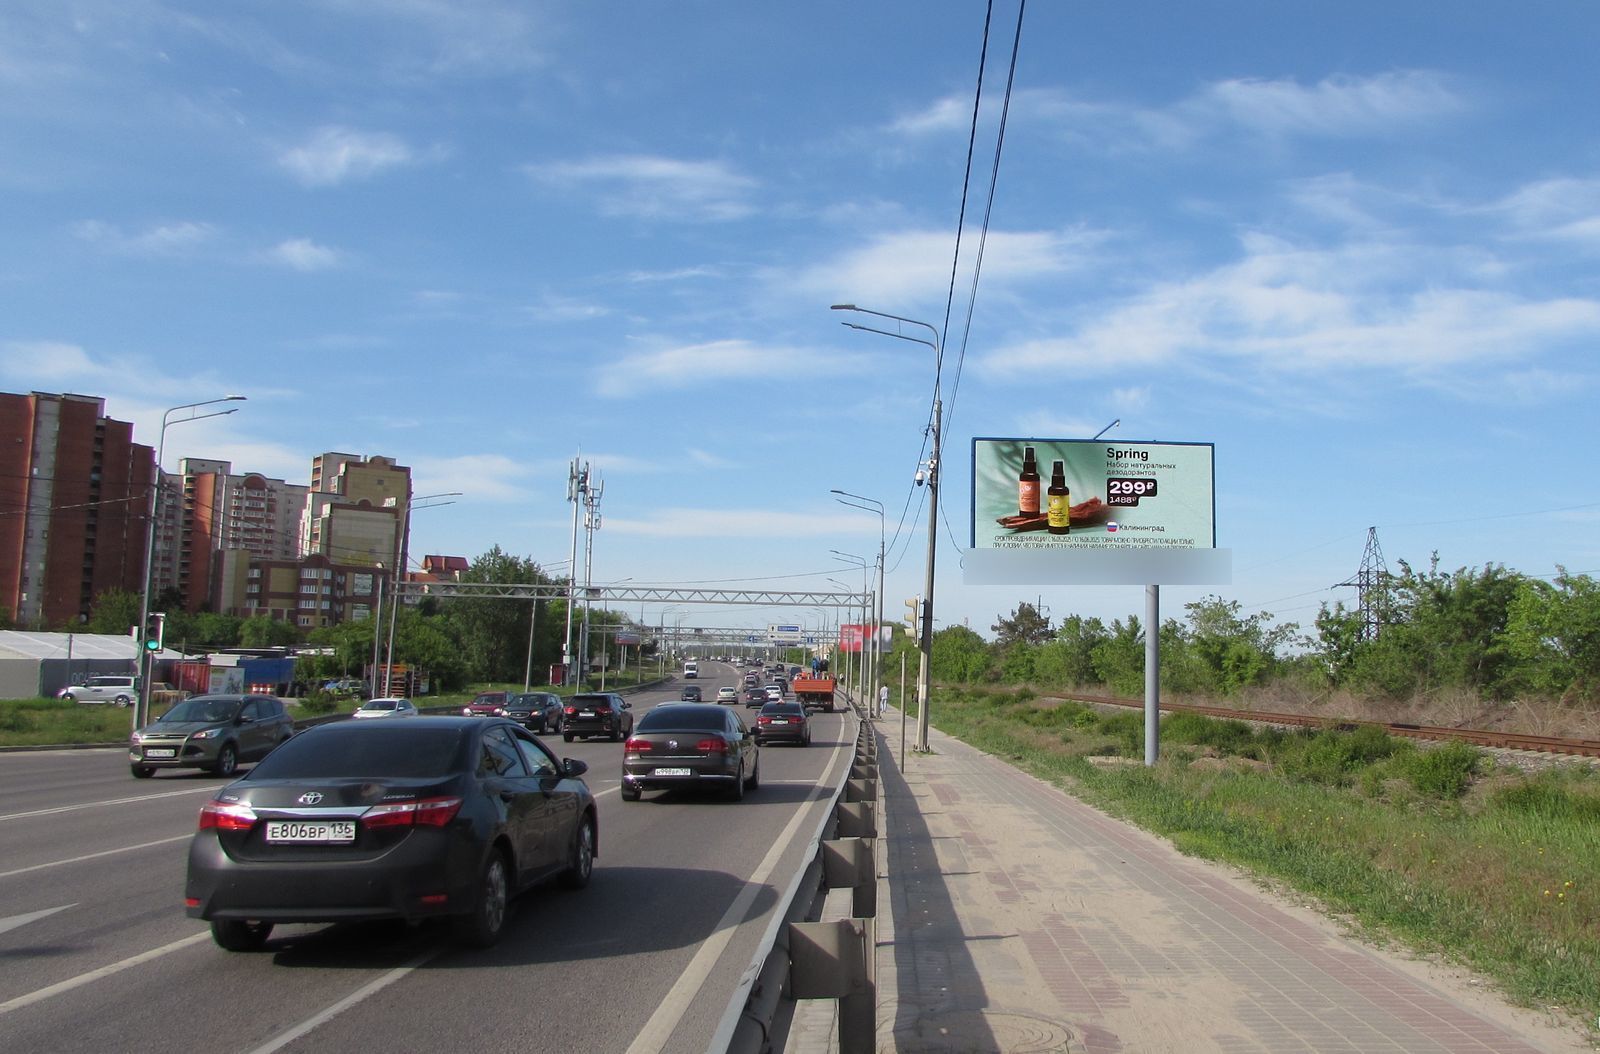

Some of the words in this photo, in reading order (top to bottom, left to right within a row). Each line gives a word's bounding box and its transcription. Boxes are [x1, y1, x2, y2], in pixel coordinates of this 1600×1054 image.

[1106, 447, 1149, 462] Spring
[1106, 461, 1129, 469] Набор
[1119, 524, 1165, 532] Калининград
[271, 823, 326, 839] Е806ВР
[330, 822, 350, 834] 136
